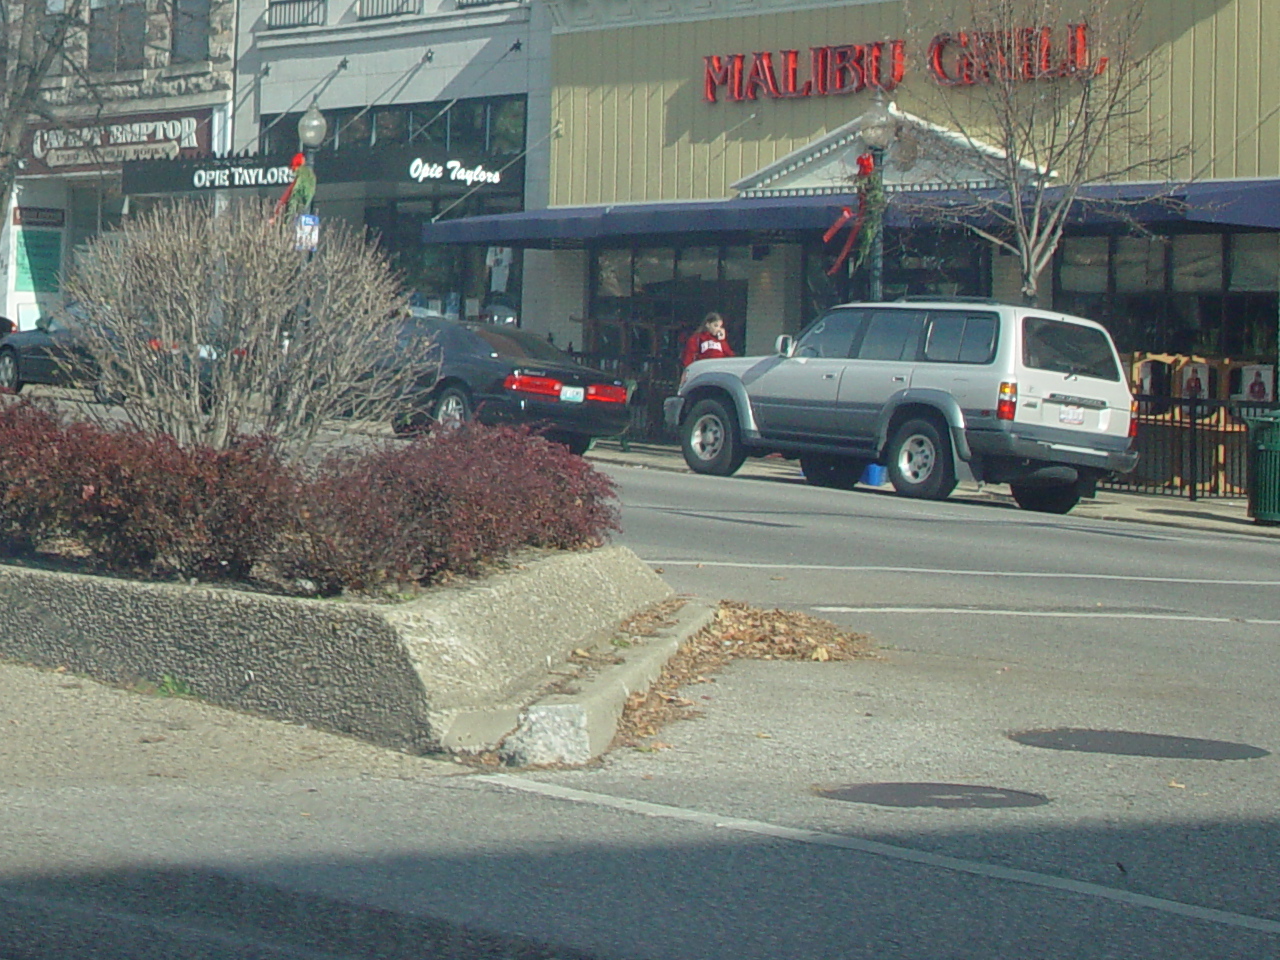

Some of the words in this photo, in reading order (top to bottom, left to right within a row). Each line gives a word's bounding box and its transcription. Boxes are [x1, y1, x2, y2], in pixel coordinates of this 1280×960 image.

[702, 39, 907, 103] MALIBU
[109, 116, 199, 150] EMPTOR
[193, 168, 230, 188] OPIE
[409, 157, 444, 183] Opie
[446, 160, 501, 187] Taylors
